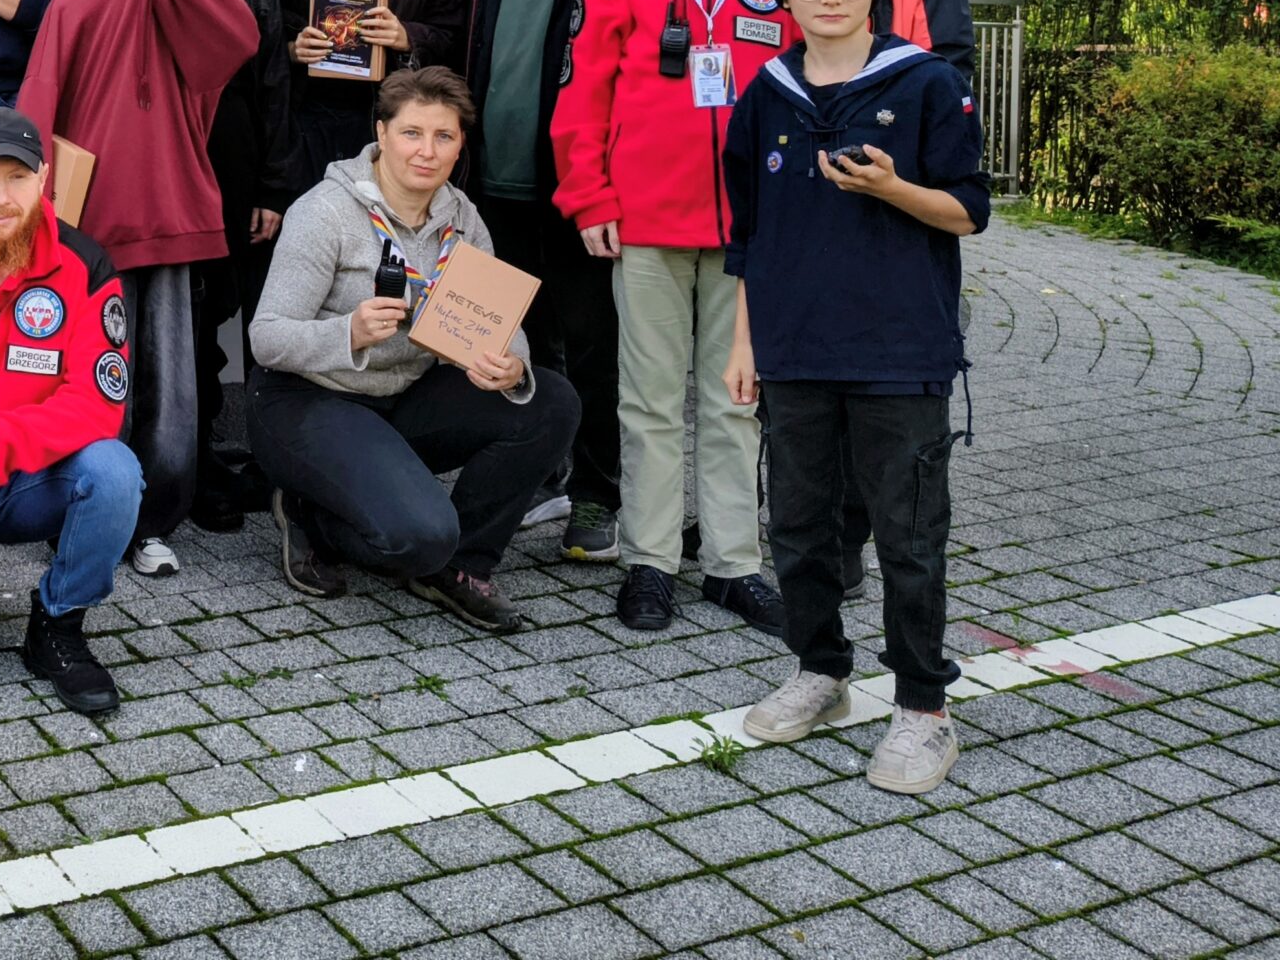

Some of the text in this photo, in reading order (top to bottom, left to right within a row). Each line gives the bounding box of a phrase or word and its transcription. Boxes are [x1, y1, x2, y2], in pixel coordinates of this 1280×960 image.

[741, 28, 777, 42] TOMASZ
[445, 289, 504, 325] RETEVIS
[464, 319, 492, 337] ZHP
[9, 358, 57, 371] GRZEGORZ
